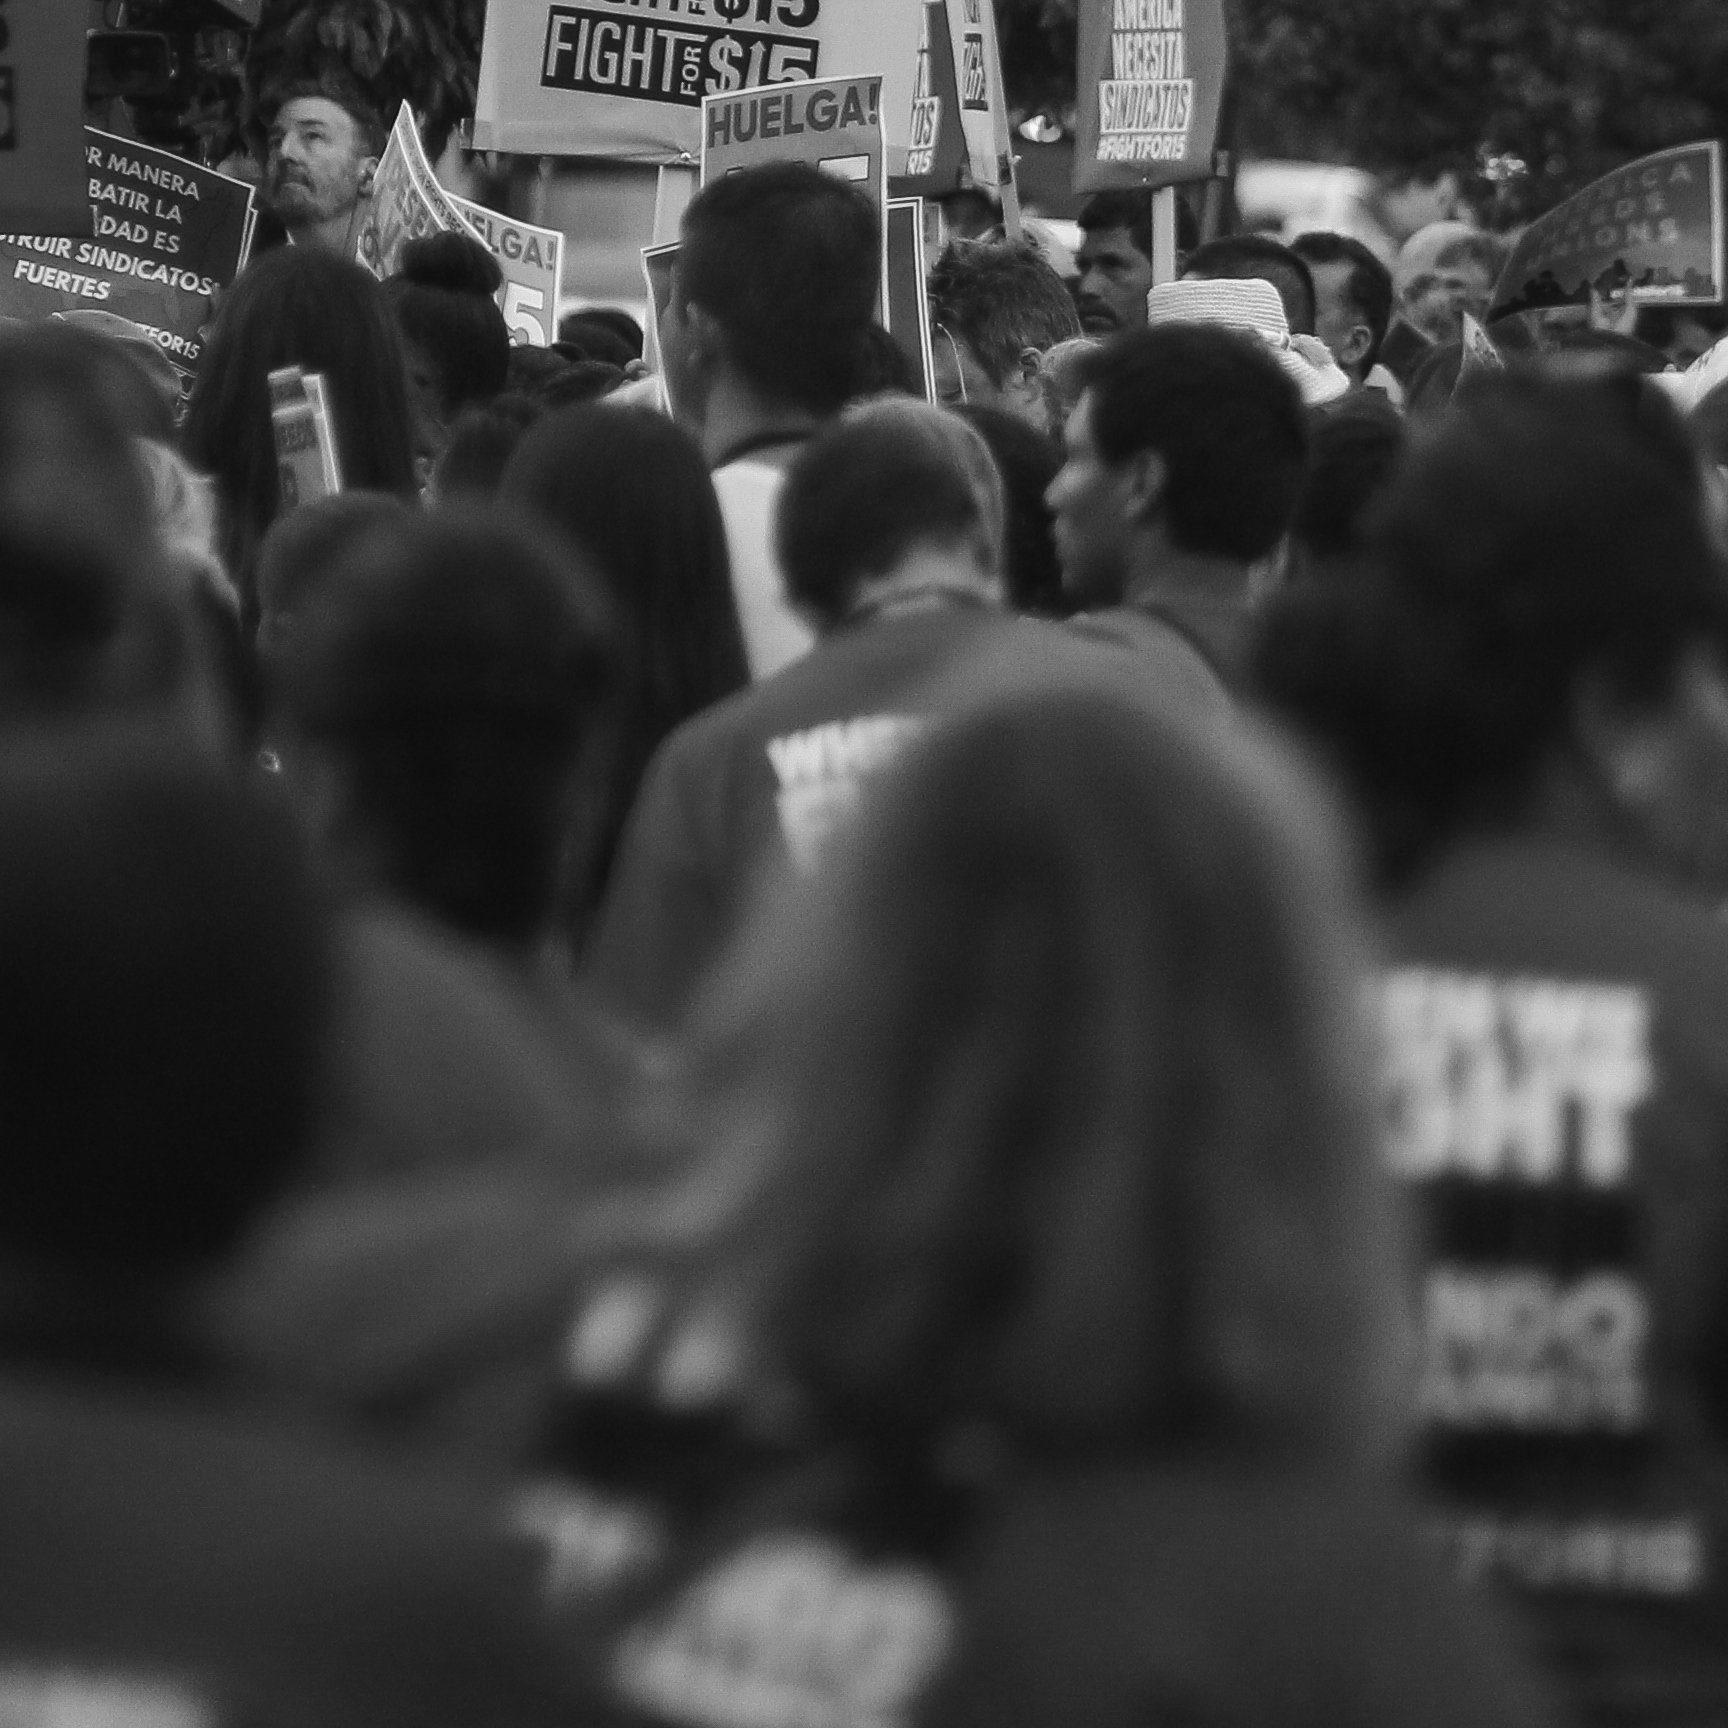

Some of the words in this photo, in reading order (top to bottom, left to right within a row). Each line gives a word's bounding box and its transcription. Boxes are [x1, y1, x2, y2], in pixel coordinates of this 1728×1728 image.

[546, 14, 708, 92] FIGHT
[679, 45, 702, 96] FOR
[708, 83, 879, 148] HUELGA!
[1103, 83, 1188, 130] SINDICATOS
[88, 177, 150, 214] BATIR
[155, 198, 183, 224] LA
[107, 152, 200, 202] MANERA
[153, 230, 181, 254] ES
[464, 208, 554, 270] ELGA!
[13, 259, 111, 300] FUERTES
[74, 242, 213, 296] SINDICATOS
